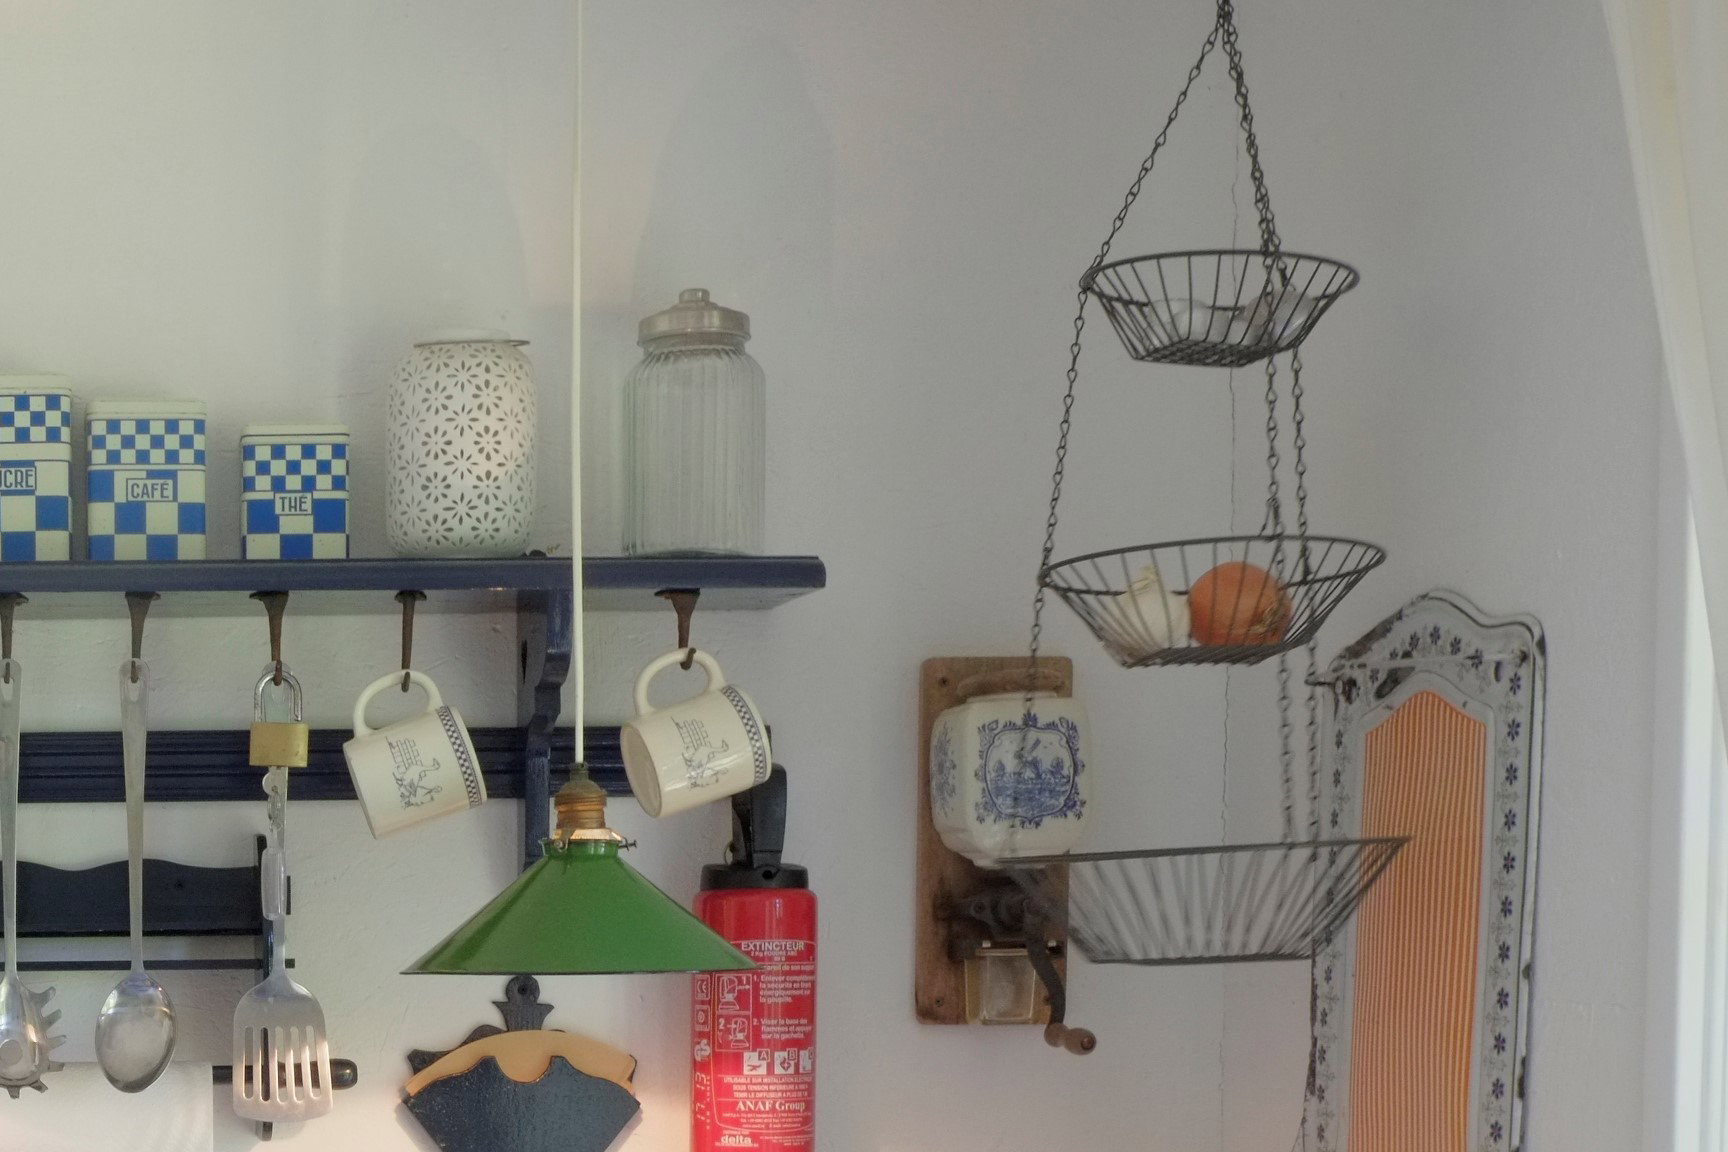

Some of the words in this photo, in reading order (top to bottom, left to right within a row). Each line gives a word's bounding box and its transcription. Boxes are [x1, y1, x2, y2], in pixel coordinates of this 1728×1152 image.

[130, 481, 170, 499] CAFÉ
[279, 495, 308, 513] THÉ
[741, 941, 805, 951] EXTINCTEUR
[761, 975, 785, 983] Enlever
[760, 1051, 768, 1061] A
[789, 1050, 797, 1059] B
[736, 1100, 773, 1112] ANAF
[775, 1101, 806, 1112] Group
[720, 1134, 752, 1145] delta
